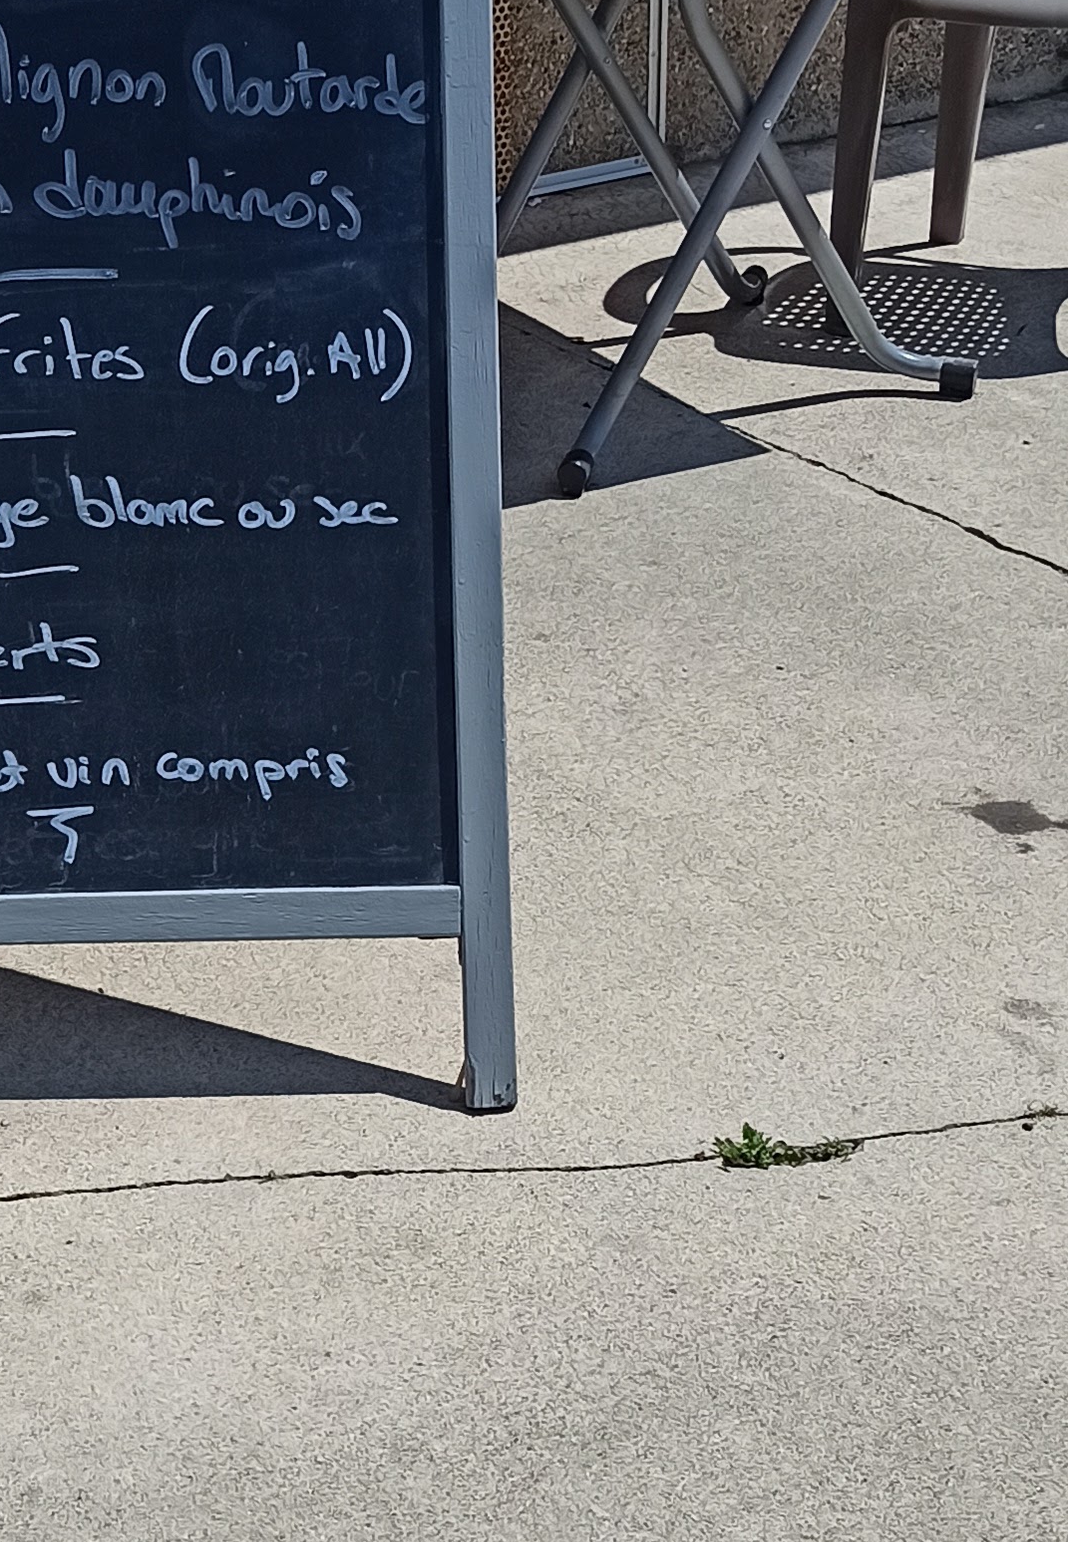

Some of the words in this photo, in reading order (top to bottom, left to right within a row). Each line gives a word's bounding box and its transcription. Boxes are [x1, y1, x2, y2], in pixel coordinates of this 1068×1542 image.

[191, 41, 430, 124] Moutarde
[32, 148, 363, 249] dauphinois
[69, 474, 226, 529] blanc
[237, 496, 298, 530] ou
[314, 495, 400, 529] sec
[46, 755, 133, 790] vin
[155, 747, 350, 801] compris
